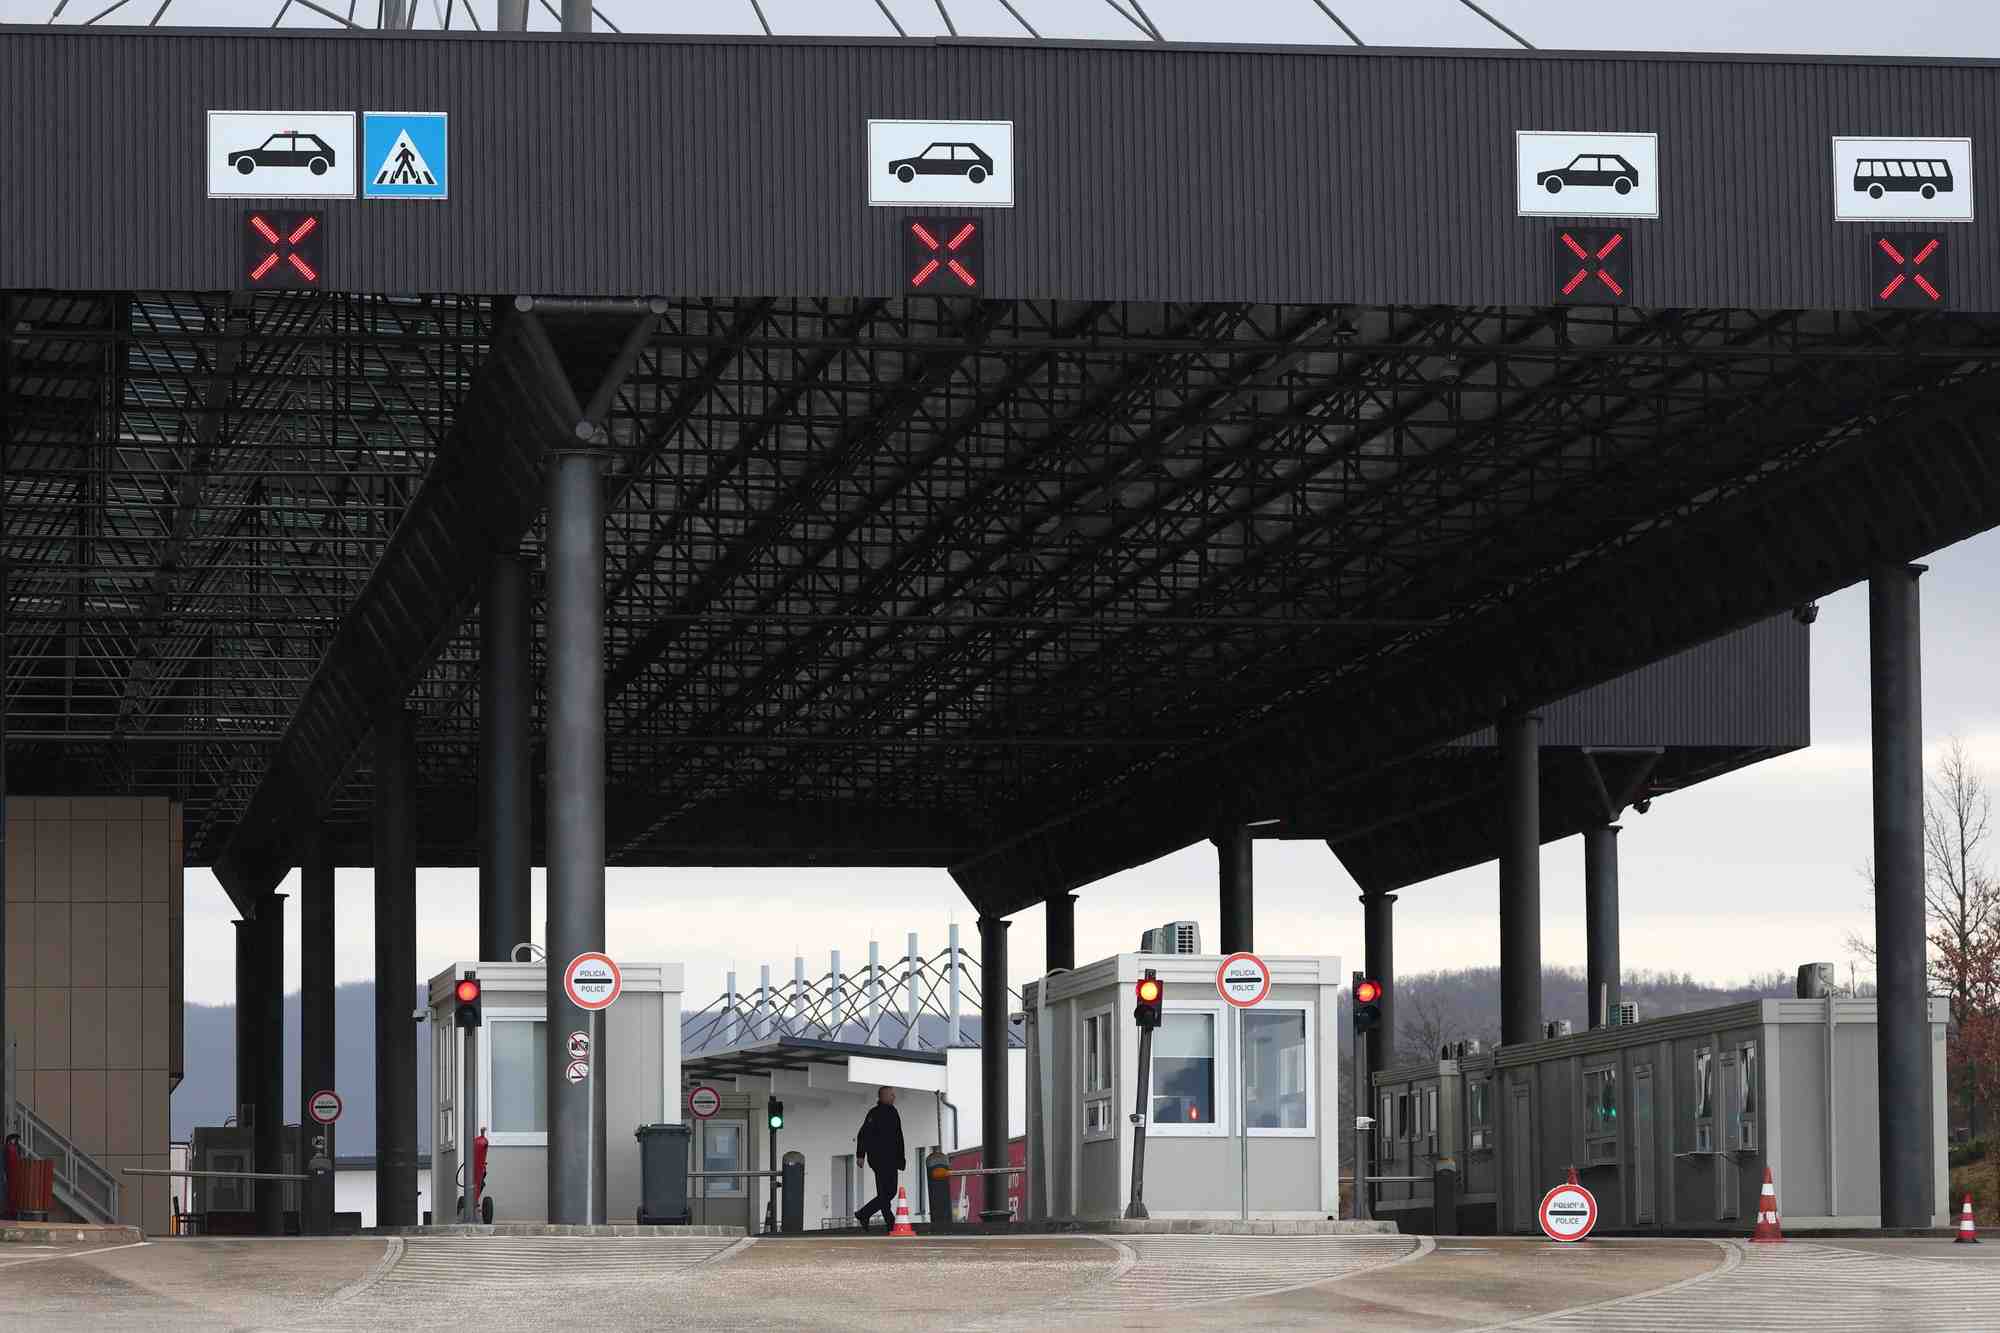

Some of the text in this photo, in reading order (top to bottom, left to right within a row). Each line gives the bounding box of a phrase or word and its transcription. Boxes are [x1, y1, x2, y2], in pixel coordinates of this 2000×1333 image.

[581, 984, 606, 993] POLICE
[1232, 983, 1257, 992] POLICE
[1555, 1216, 1581, 1225] POLICE
